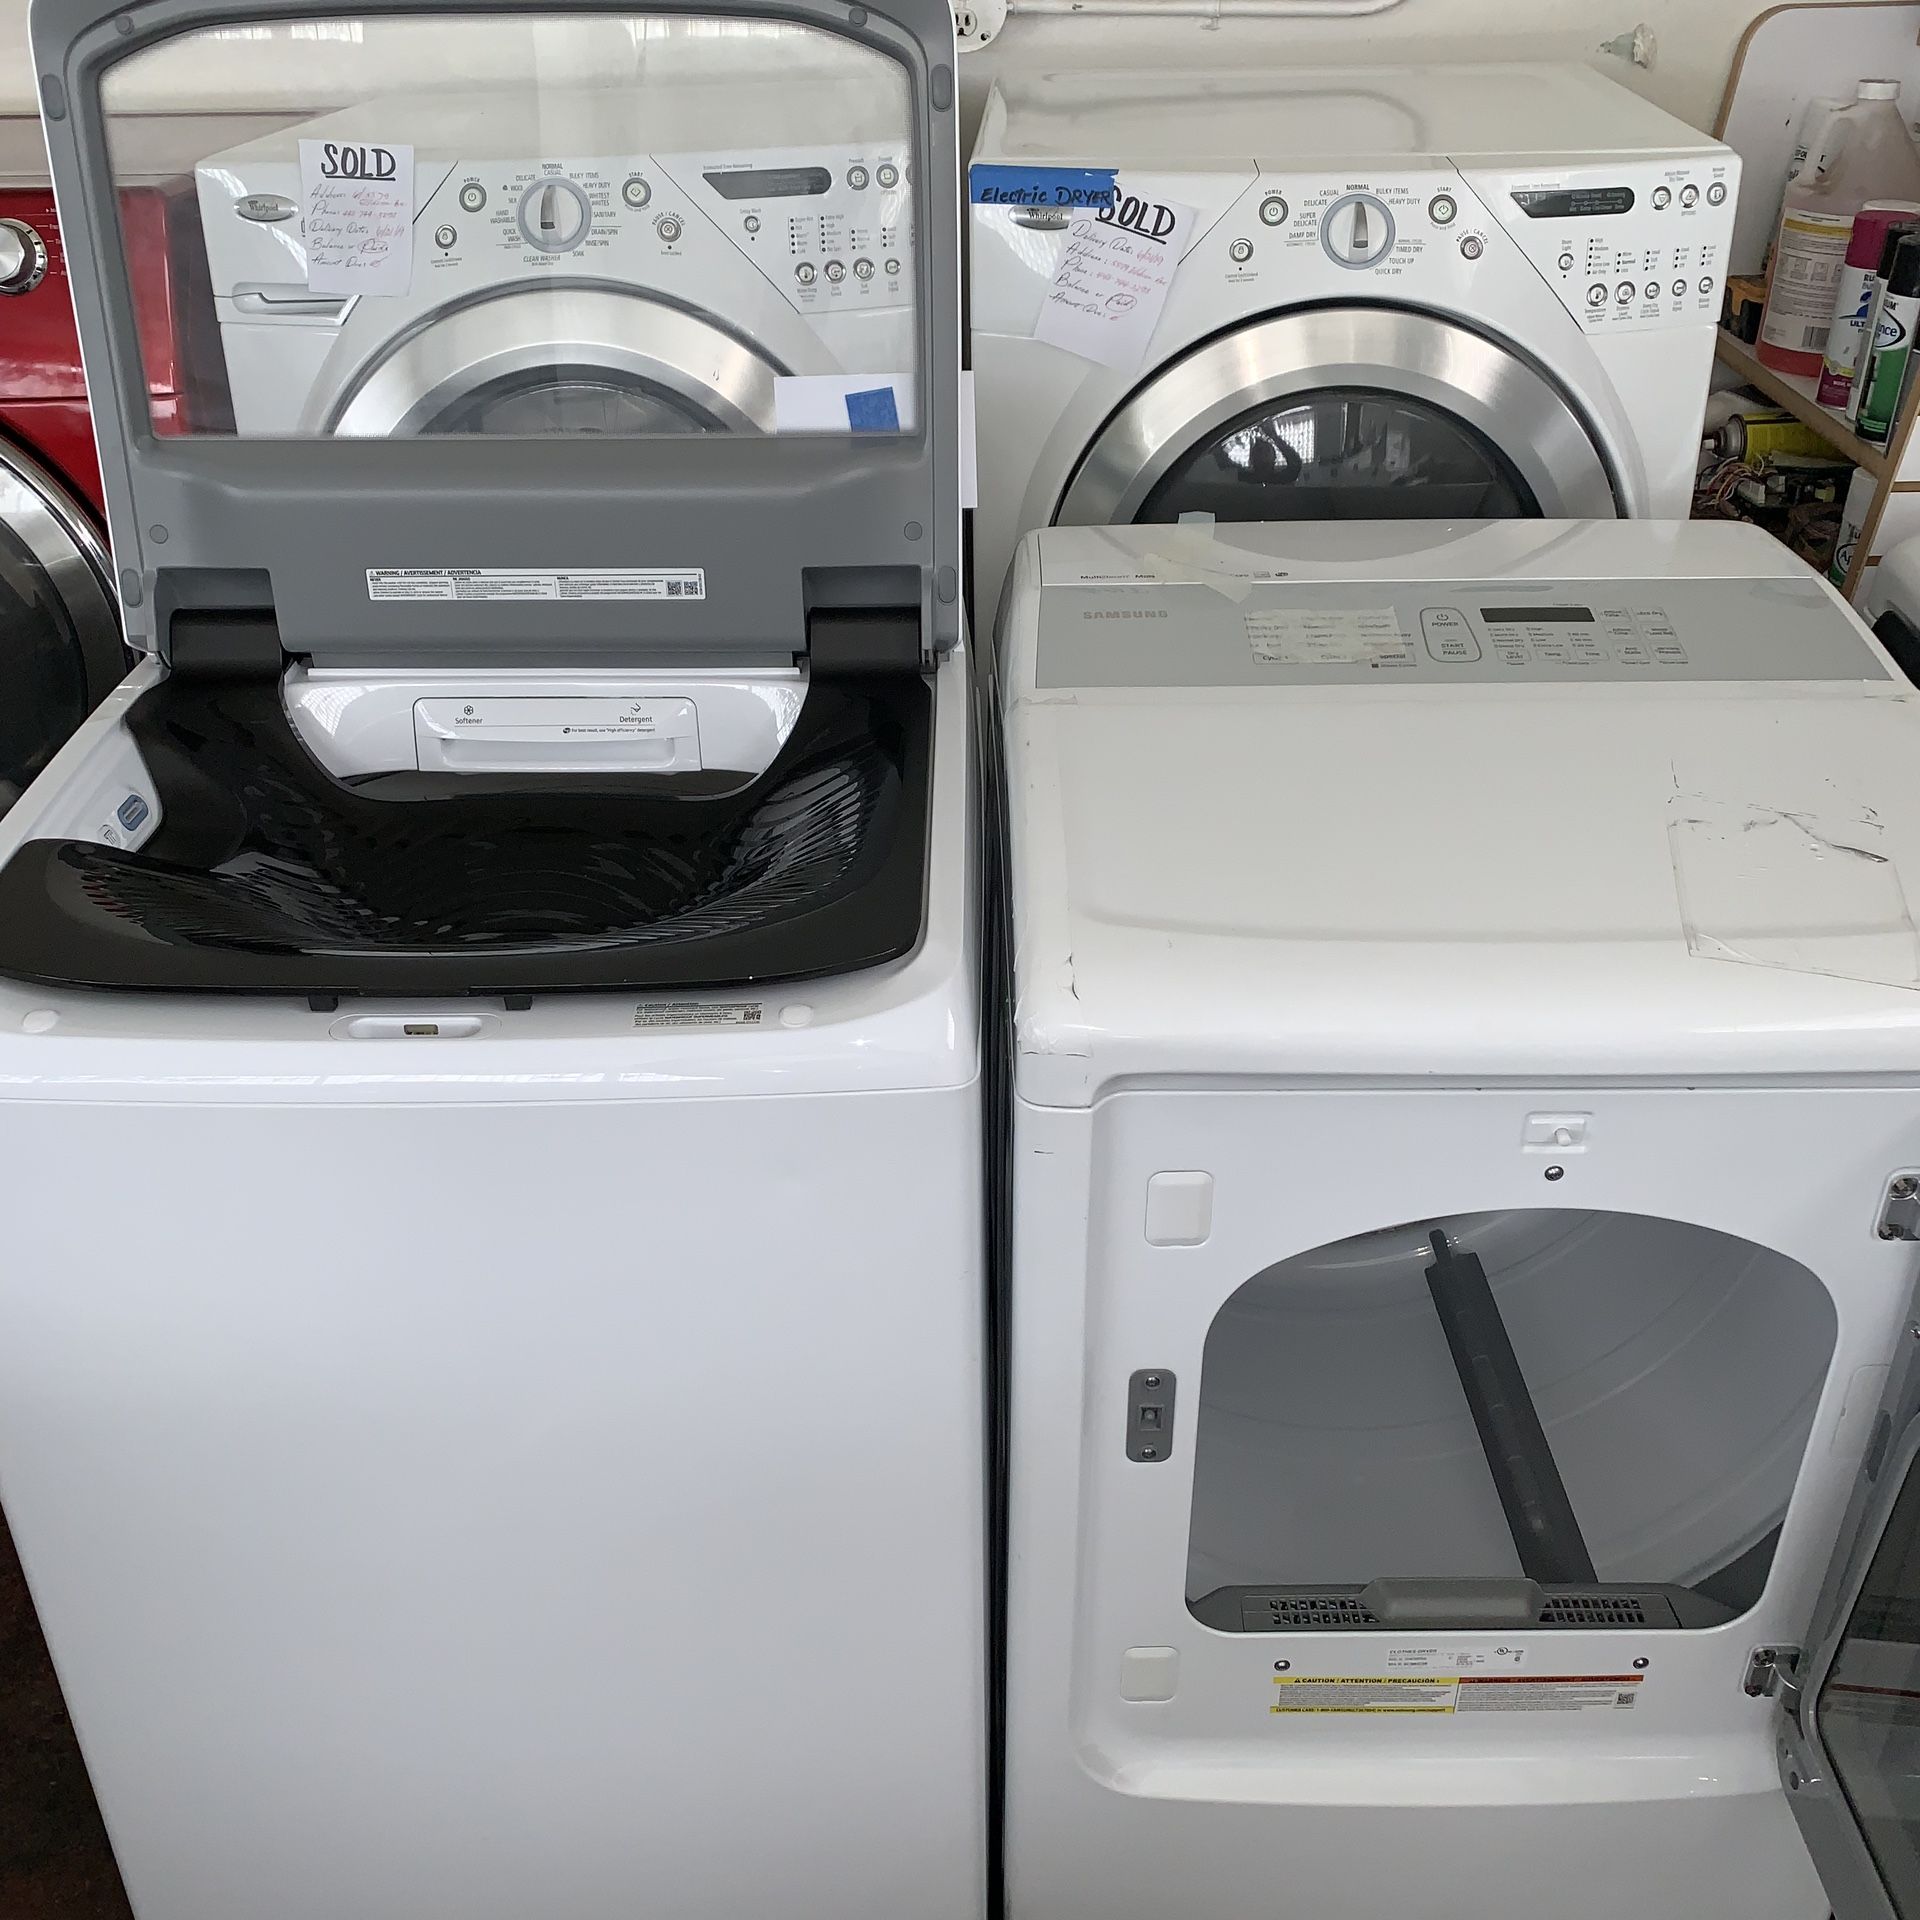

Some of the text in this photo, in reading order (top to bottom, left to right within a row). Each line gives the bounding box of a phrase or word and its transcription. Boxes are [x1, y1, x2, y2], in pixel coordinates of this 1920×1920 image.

[320, 143, 396, 177] SOLD
[515, 174, 536, 182] DELICATE
[980, 185, 1113, 207] Electric DRYER
[1319, 189, 1339, 197] CASUAL
[1304, 199, 1328, 207] DELICATE
[1027, 208, 1063, 222] Whirlpool
[1293, 219, 1317, 227] DELICATE
[1083, 610, 1168, 619] SAMSUNG
[619, 715, 653, 724] Detergent
